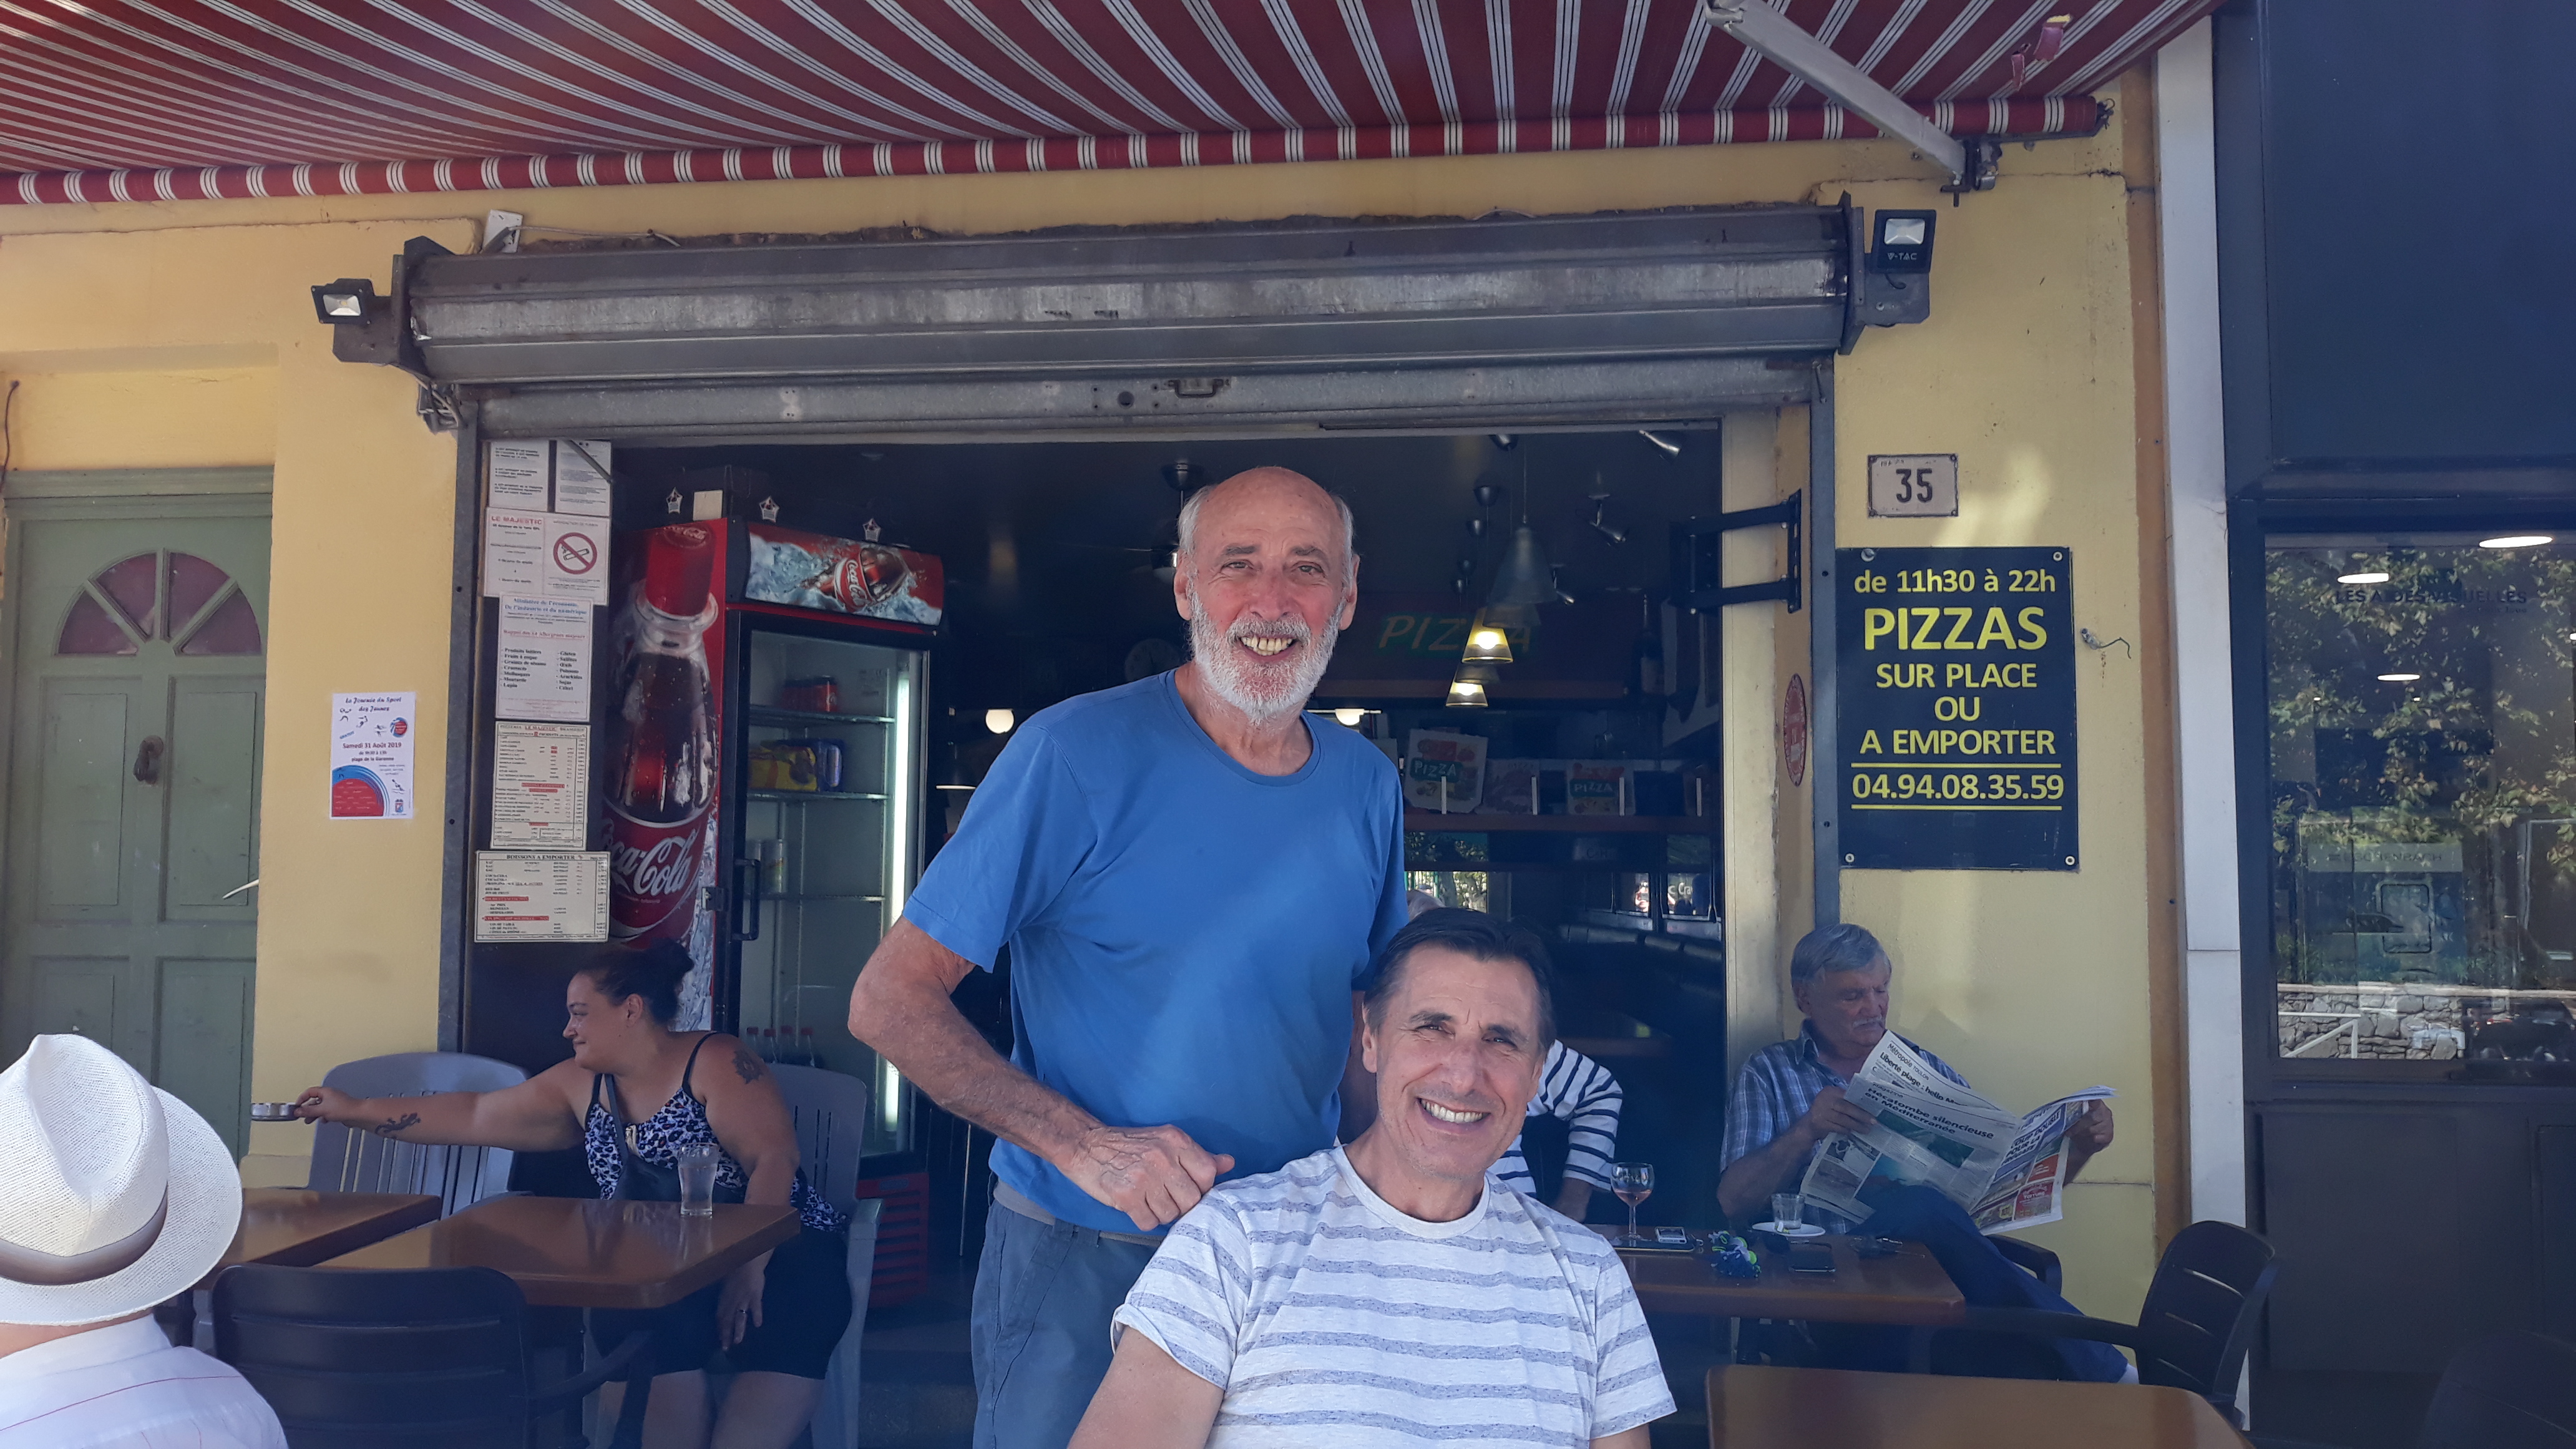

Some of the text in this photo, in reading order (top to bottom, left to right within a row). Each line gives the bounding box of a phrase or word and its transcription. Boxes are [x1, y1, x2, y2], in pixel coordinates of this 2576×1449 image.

[1896, 468, 1933, 503] 35
[1855, 568, 2056, 593] de 11h30 à 22h
[1378, 615, 1532, 653] PIZA
[1865, 607, 2047, 650] PIZZAS
[1876, 663, 2037, 688] SUR PLACE
[1934, 696, 1980, 721] OU
[1860, 729, 2056, 754] A EMPORTER
[1413, 761, 1457, 779] PIZZA
[1573, 782, 1614, 793] PIZZA
[1853, 774, 2064, 799] 04.94.08.35.59
[1887, 1043, 1913, 1068] Métropole
[1880, 1051, 1902, 1073] Liberté
[1901, 1070, 1921, 1088] plage
[1925, 1086, 1944, 1101] hello
[1864, 1092, 1956, 1134] en Méditerranée
[1868, 1088, 1930, 1118] Hécatombe
[1932, 1115, 1994, 1139] silencieuse
